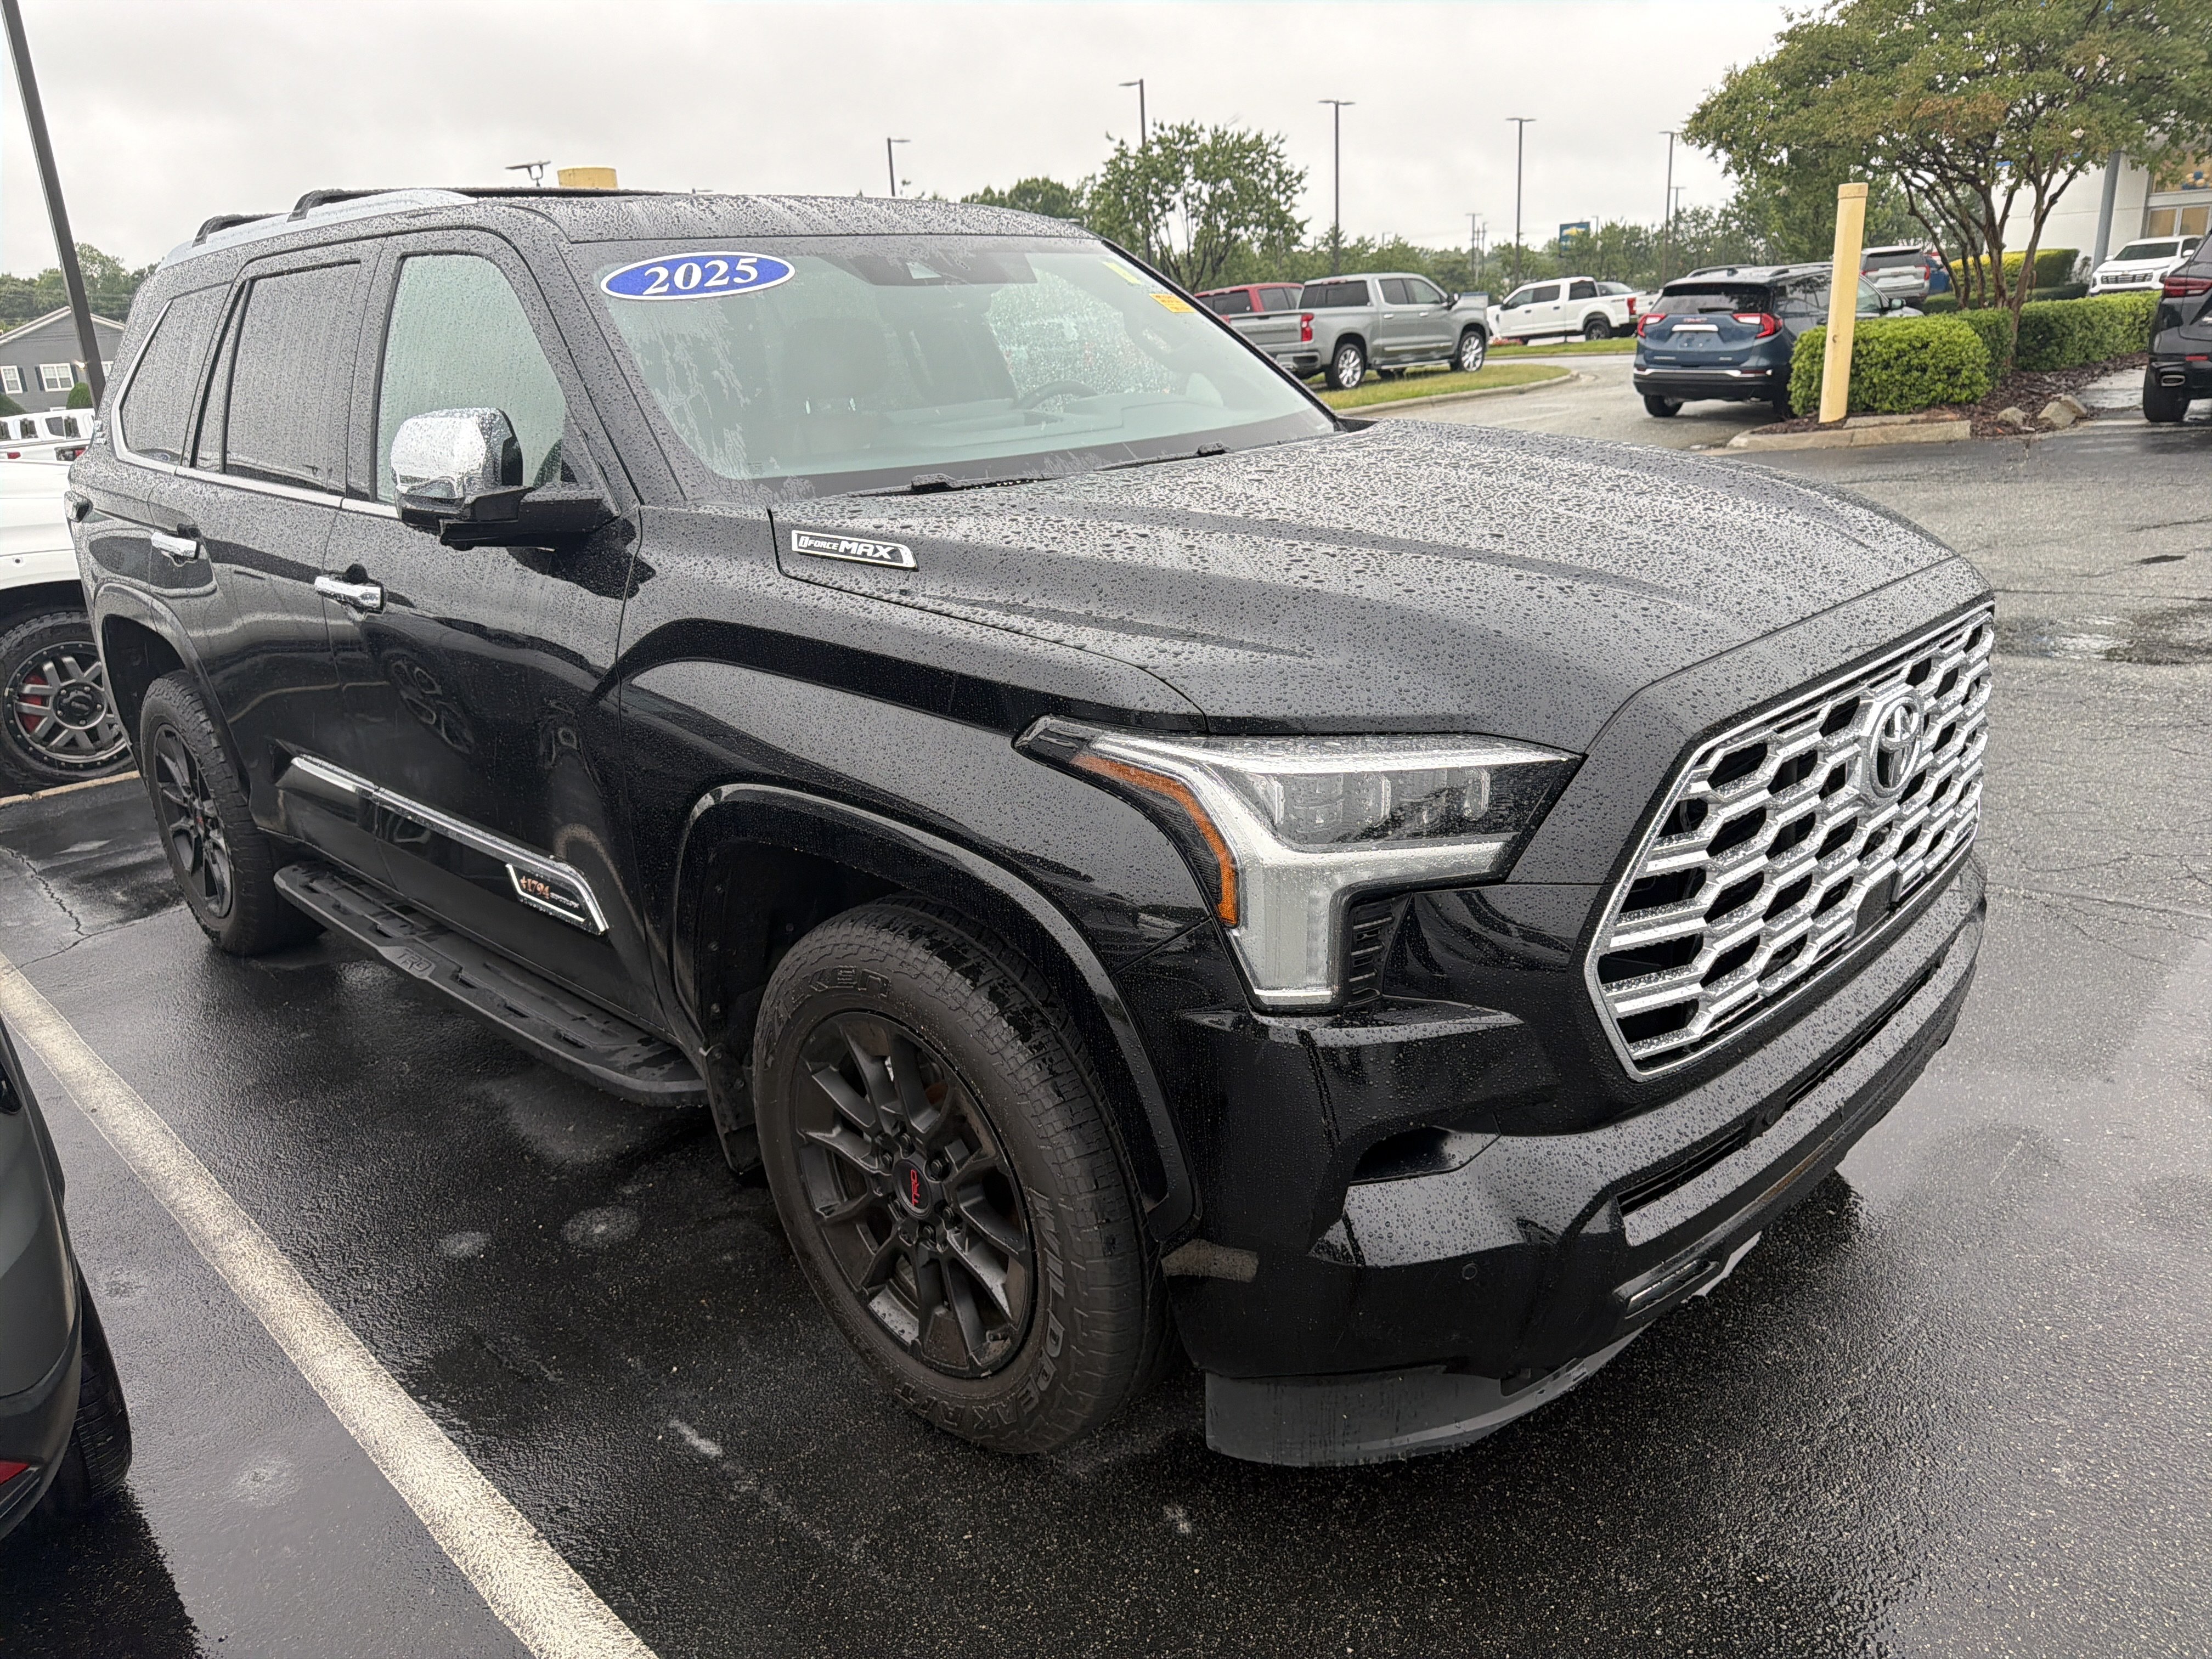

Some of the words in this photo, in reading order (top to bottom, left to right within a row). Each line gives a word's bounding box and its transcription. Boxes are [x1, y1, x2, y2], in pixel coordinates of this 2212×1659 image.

[642, 257, 758, 295] 2025
[838, 540, 896, 560] MAX
[397, 948, 432, 972] TRD
[911, 1169, 921, 1206] TRD
[969, 1187, 1066, 1427] WILDPEAK
